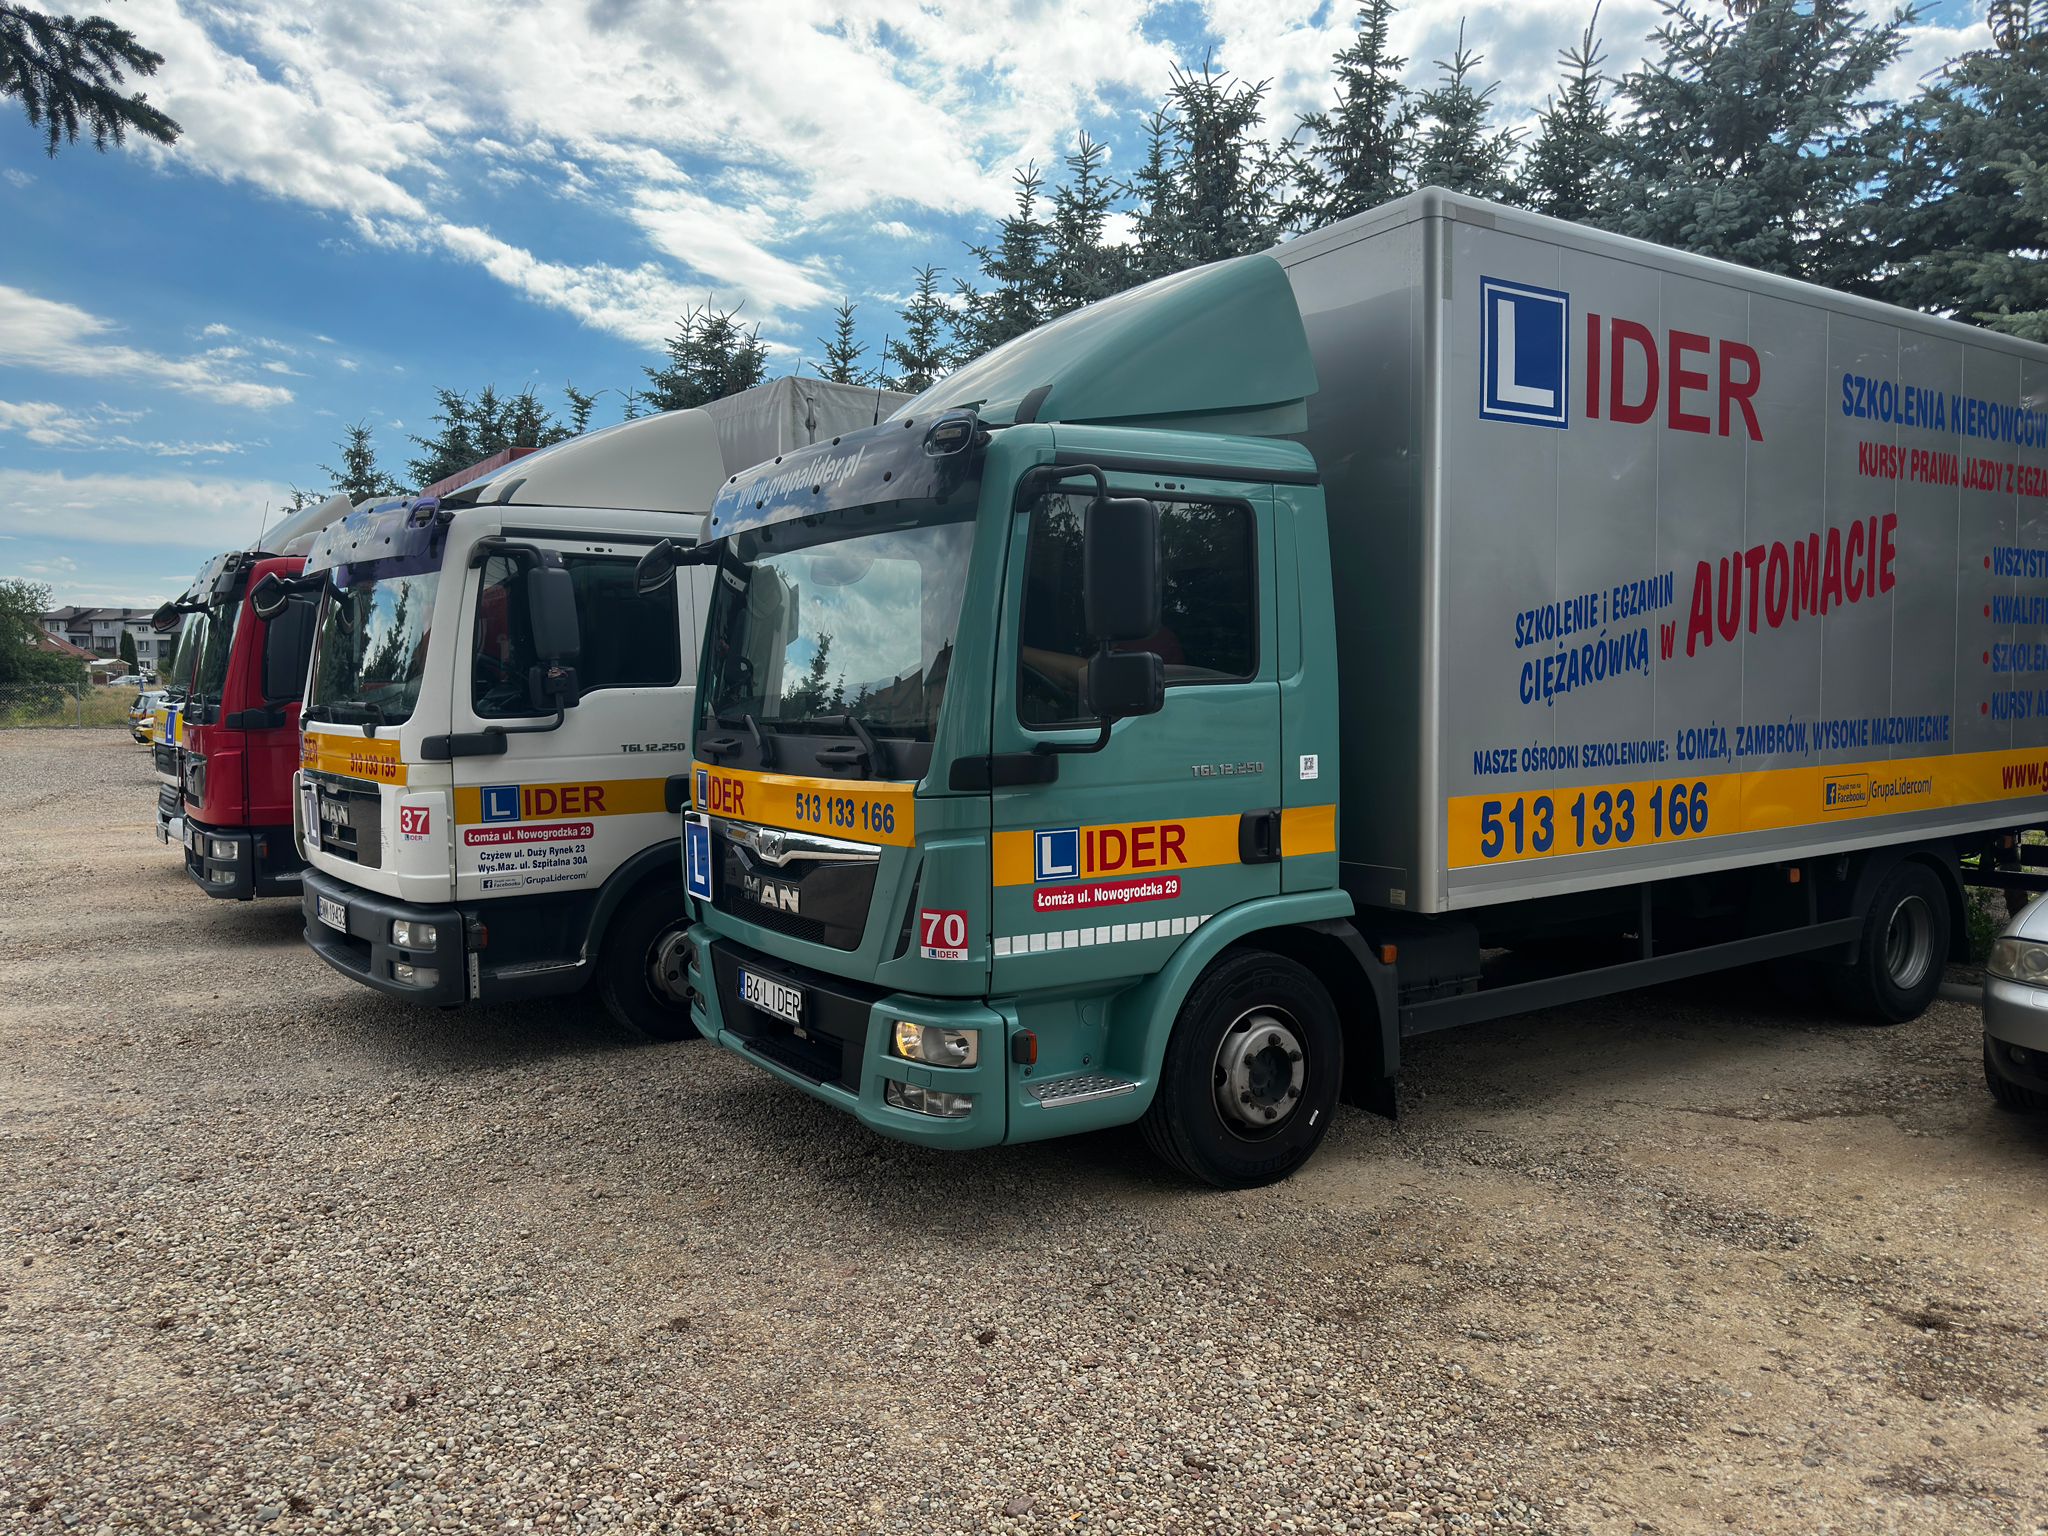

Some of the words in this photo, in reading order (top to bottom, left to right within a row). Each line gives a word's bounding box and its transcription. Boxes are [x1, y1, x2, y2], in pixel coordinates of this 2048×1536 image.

[1842, 373, 1946, 432] SZKOLENIA
[737, 445, 866, 509] www.grupalider.pl
[1859, 441, 1906, 480] KURSY
[1911, 449, 1959, 486] PRAWA
[1962, 456, 2003, 492] JAZDY
[2006, 463, 2015, 494] Z
[1993, 546, 2048, 578] WSZYST
[1515, 593, 1599, 649] SZKOLENIE
[1613, 571, 1673, 622] EGZAMIN
[1519, 627, 1650, 707] CIĘŻARÓWKĄ
[1686, 513, 1898, 658] AUTOMACIE
[1993, 595, 2048, 625] KWALIFI
[1992, 690, 2033, 720] KURSY
[2037, 688, 2048, 718] A
[621, 744, 643, 752] TGL
[645, 742, 686, 751] 12.250
[1473, 748, 1517, 775] NASZE
[1521, 740, 1579, 773] OŚRODKI
[1582, 740, 1669, 769] SZKOLENIOWE:
[1676, 720, 1731, 763] ŁOMŻA,
[1735, 714, 1808, 758] ZAMBRÓW,
[1812, 719, 1869, 751] WYSOKIE
[1872, 715, 1950, 746] MAZOWIECKIE
[1191, 764, 1218, 777] TGL
[1219, 761, 1265, 775] 12.250
[402, 809, 428, 832] 37
[796, 793, 821, 823] 513
[827, 796, 854, 828] 133
[861, 801, 895, 834] 166
[1481, 796, 1554, 858] 513
[1571, 788, 1635, 847] 133
[1650, 781, 1708, 838] 166
[468, 832, 500, 843] Łomża
[502, 832, 514, 841] ul.
[517, 827, 578, 841] Nowogrodzka
[580, 826, 591, 836] 29
[480, 850, 511, 862] Czyżew
[514, 849, 525, 858] ul.
[527, 847, 547, 857] Duży
[549, 845, 573, 857] Rynek
[575, 844, 585, 853] 23
[520, 861, 530, 869] ul.
[532, 858, 570, 869] Szpitalna
[572, 856, 588, 865] 30A
[693, 835, 705, 885] L
[744, 875, 799, 913] MAN
[1037, 890, 1075, 907] Łomża
[1077, 889, 1091, 903] ul.
[1094, 882, 1163, 902] Nowogrodzka
[1165, 880, 1178, 893] 29
[922, 912, 965, 947] 70
[929, 949, 959, 959] LIDER
[746, 974, 760, 1002] B6
[763, 981, 800, 1018] LIDER
